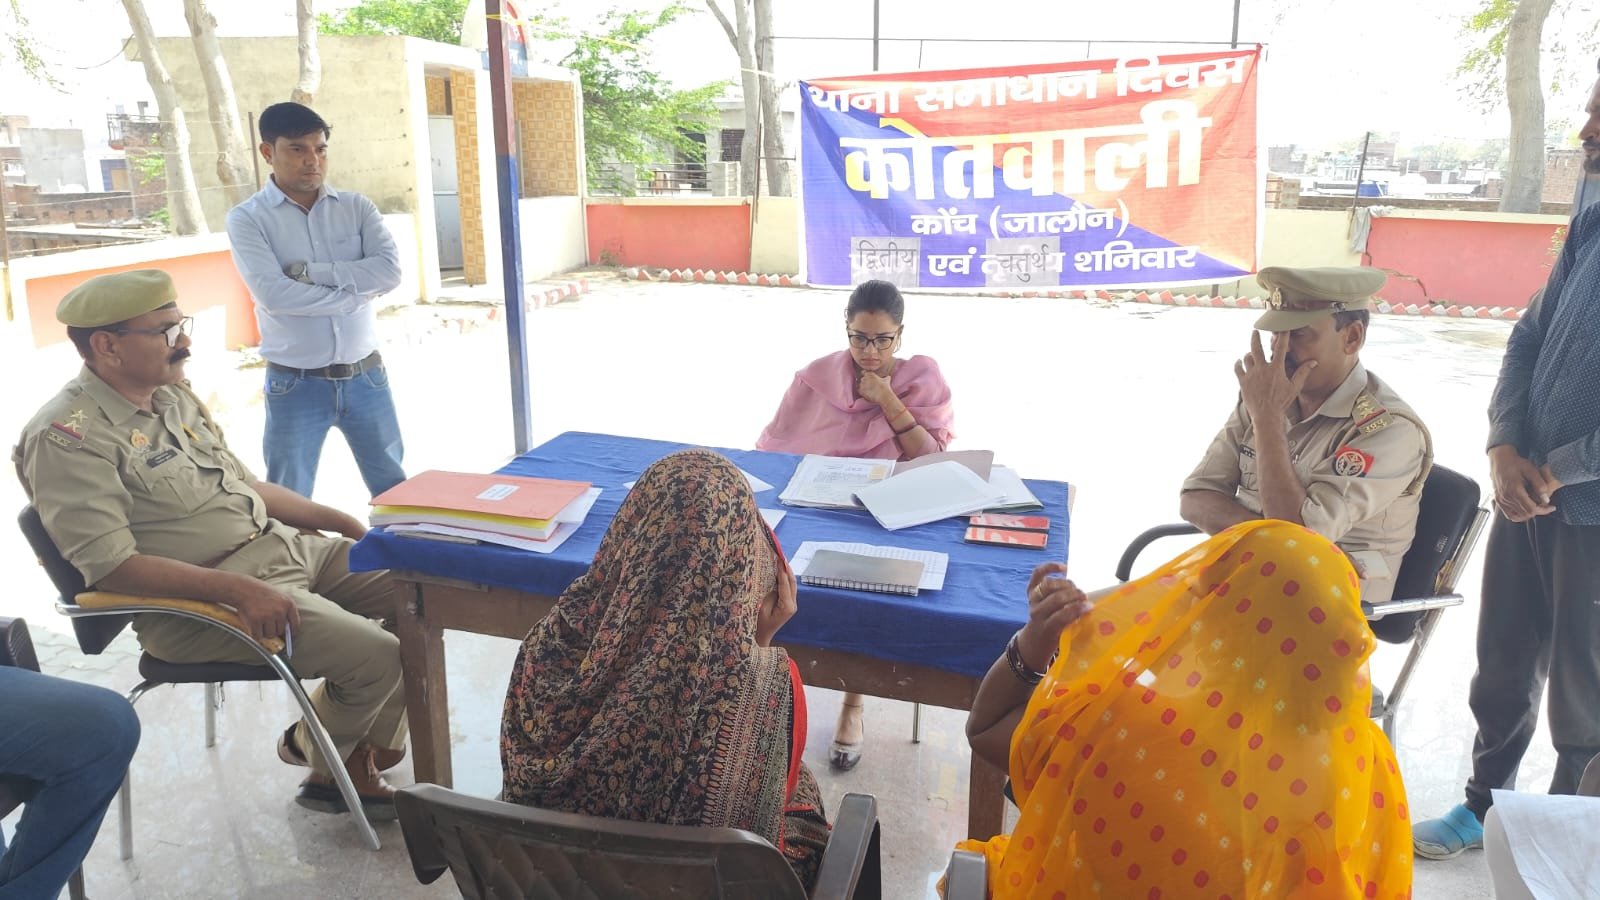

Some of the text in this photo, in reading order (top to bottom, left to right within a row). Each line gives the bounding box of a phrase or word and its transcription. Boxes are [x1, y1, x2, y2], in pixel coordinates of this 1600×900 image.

[807, 54, 1251, 115] थाना समाधान दिवस
[839, 99, 1213, 201] कोतवाली
[911, 199, 1130, 239] कोंच (जालौन)
[927, 246, 977, 277] एवं
[1073, 240, 1201, 272] शनिवार
